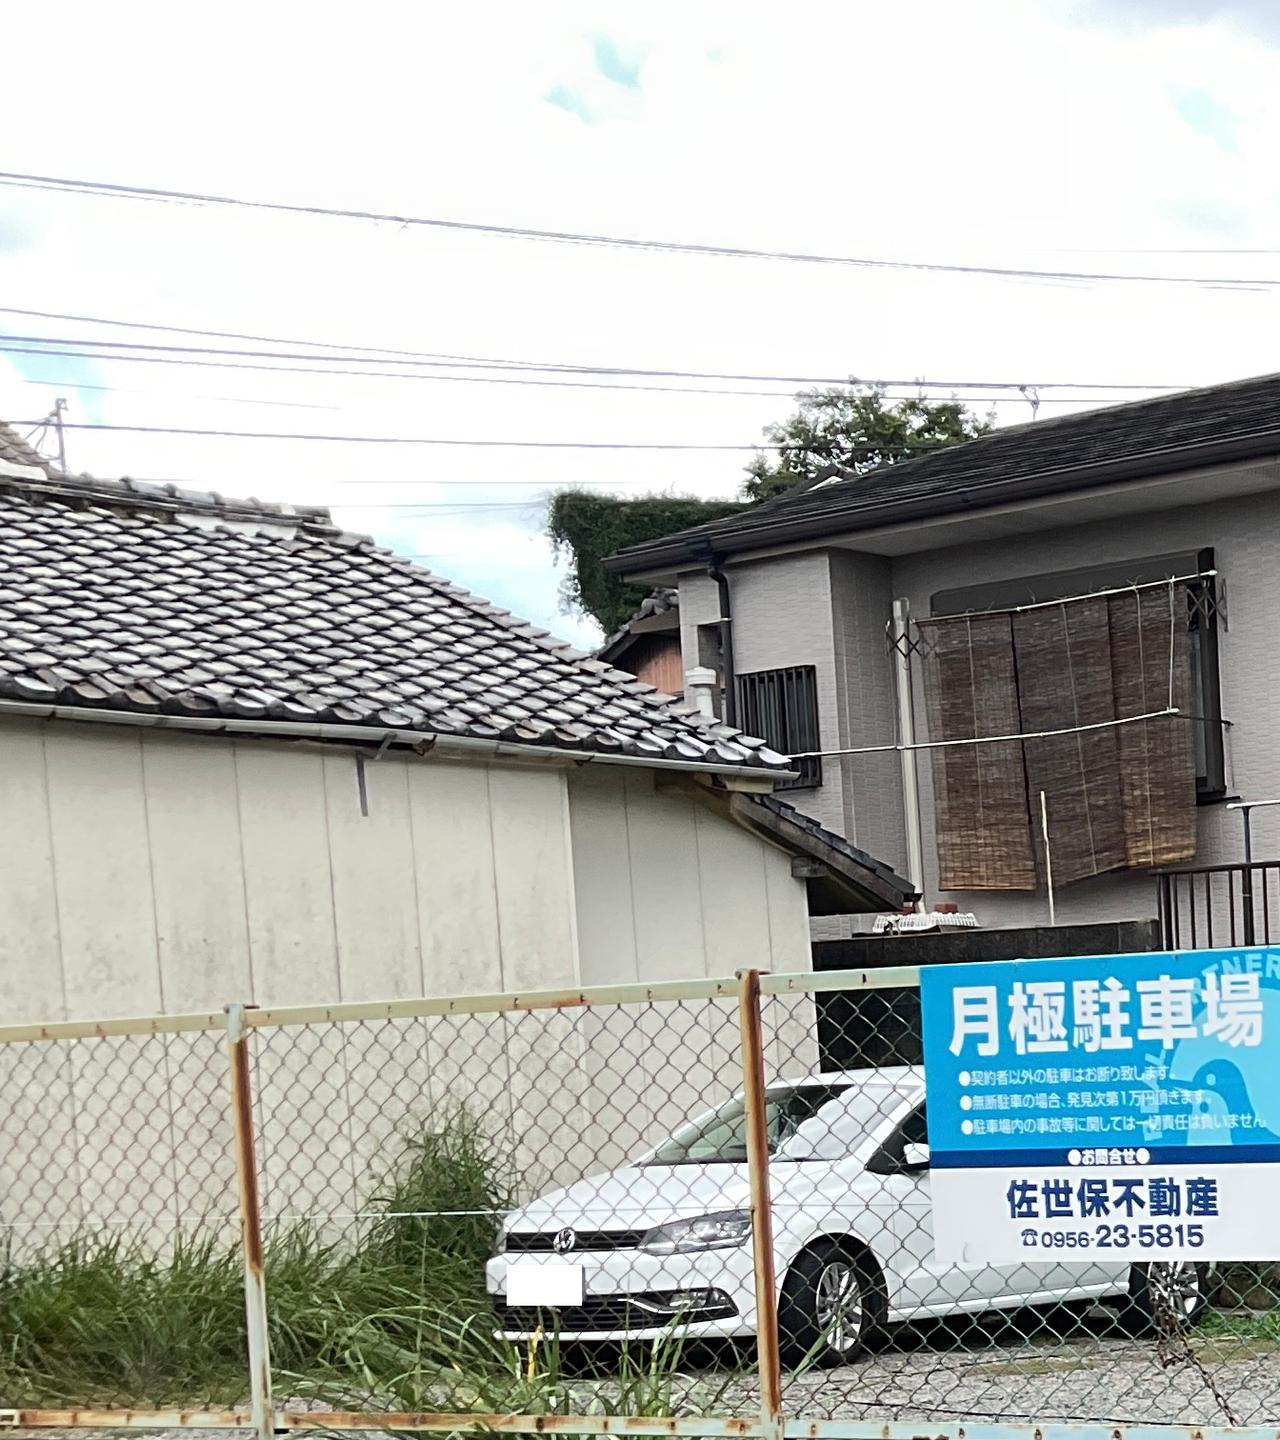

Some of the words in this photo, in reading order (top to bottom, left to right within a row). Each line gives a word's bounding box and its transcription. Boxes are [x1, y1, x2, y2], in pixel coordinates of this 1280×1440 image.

[949, 974, 1264, 1057] 月極駐車場
[1081, 1148, 1137, 1165] お問合せ
[1006, 1176, 1219, 1219] 佐世保不動産
[1041, 1224, 1205, 1249] 0956-23-5815
